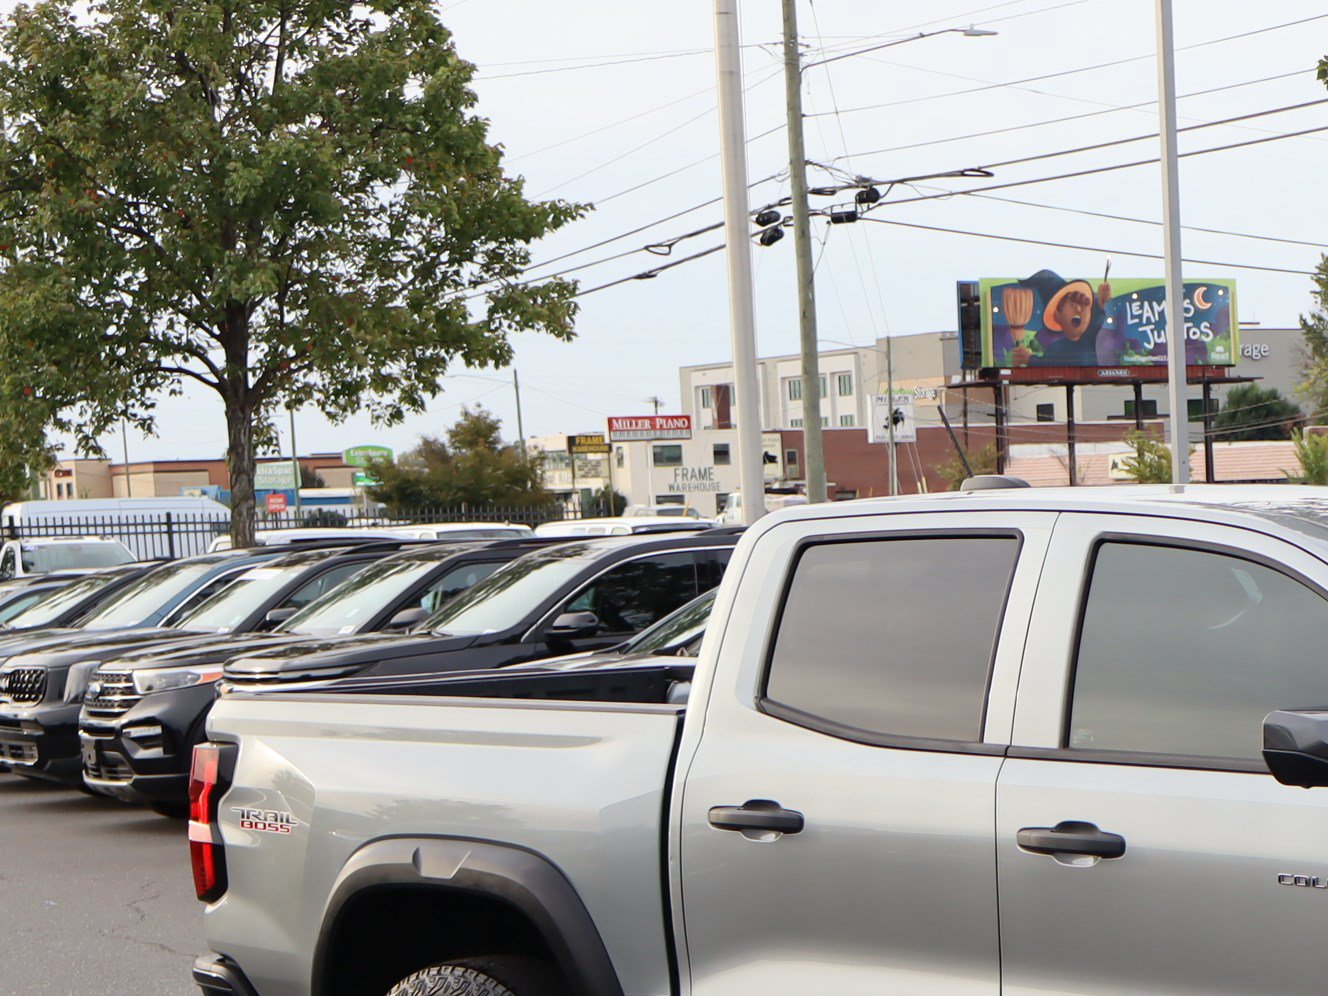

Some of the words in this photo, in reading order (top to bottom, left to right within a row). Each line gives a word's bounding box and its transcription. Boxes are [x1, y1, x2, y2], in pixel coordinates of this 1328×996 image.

[1126, 299, 1194, 325] LEAMS
[1138, 321, 1213, 350] JUTOS
[1211, 351, 1229, 361] Read
[1240, 344, 1270, 360] rage
[612, 419, 651, 430] MILLER
[655, 418, 689, 430] PIANO
[575, 436, 605, 445] FRAME
[674, 466, 715, 483] FRAME
[668, 481, 722, 493] WAREHOUSE
[231, 807, 299, 827] TRAIL
[240, 820, 292, 835] BOSS
